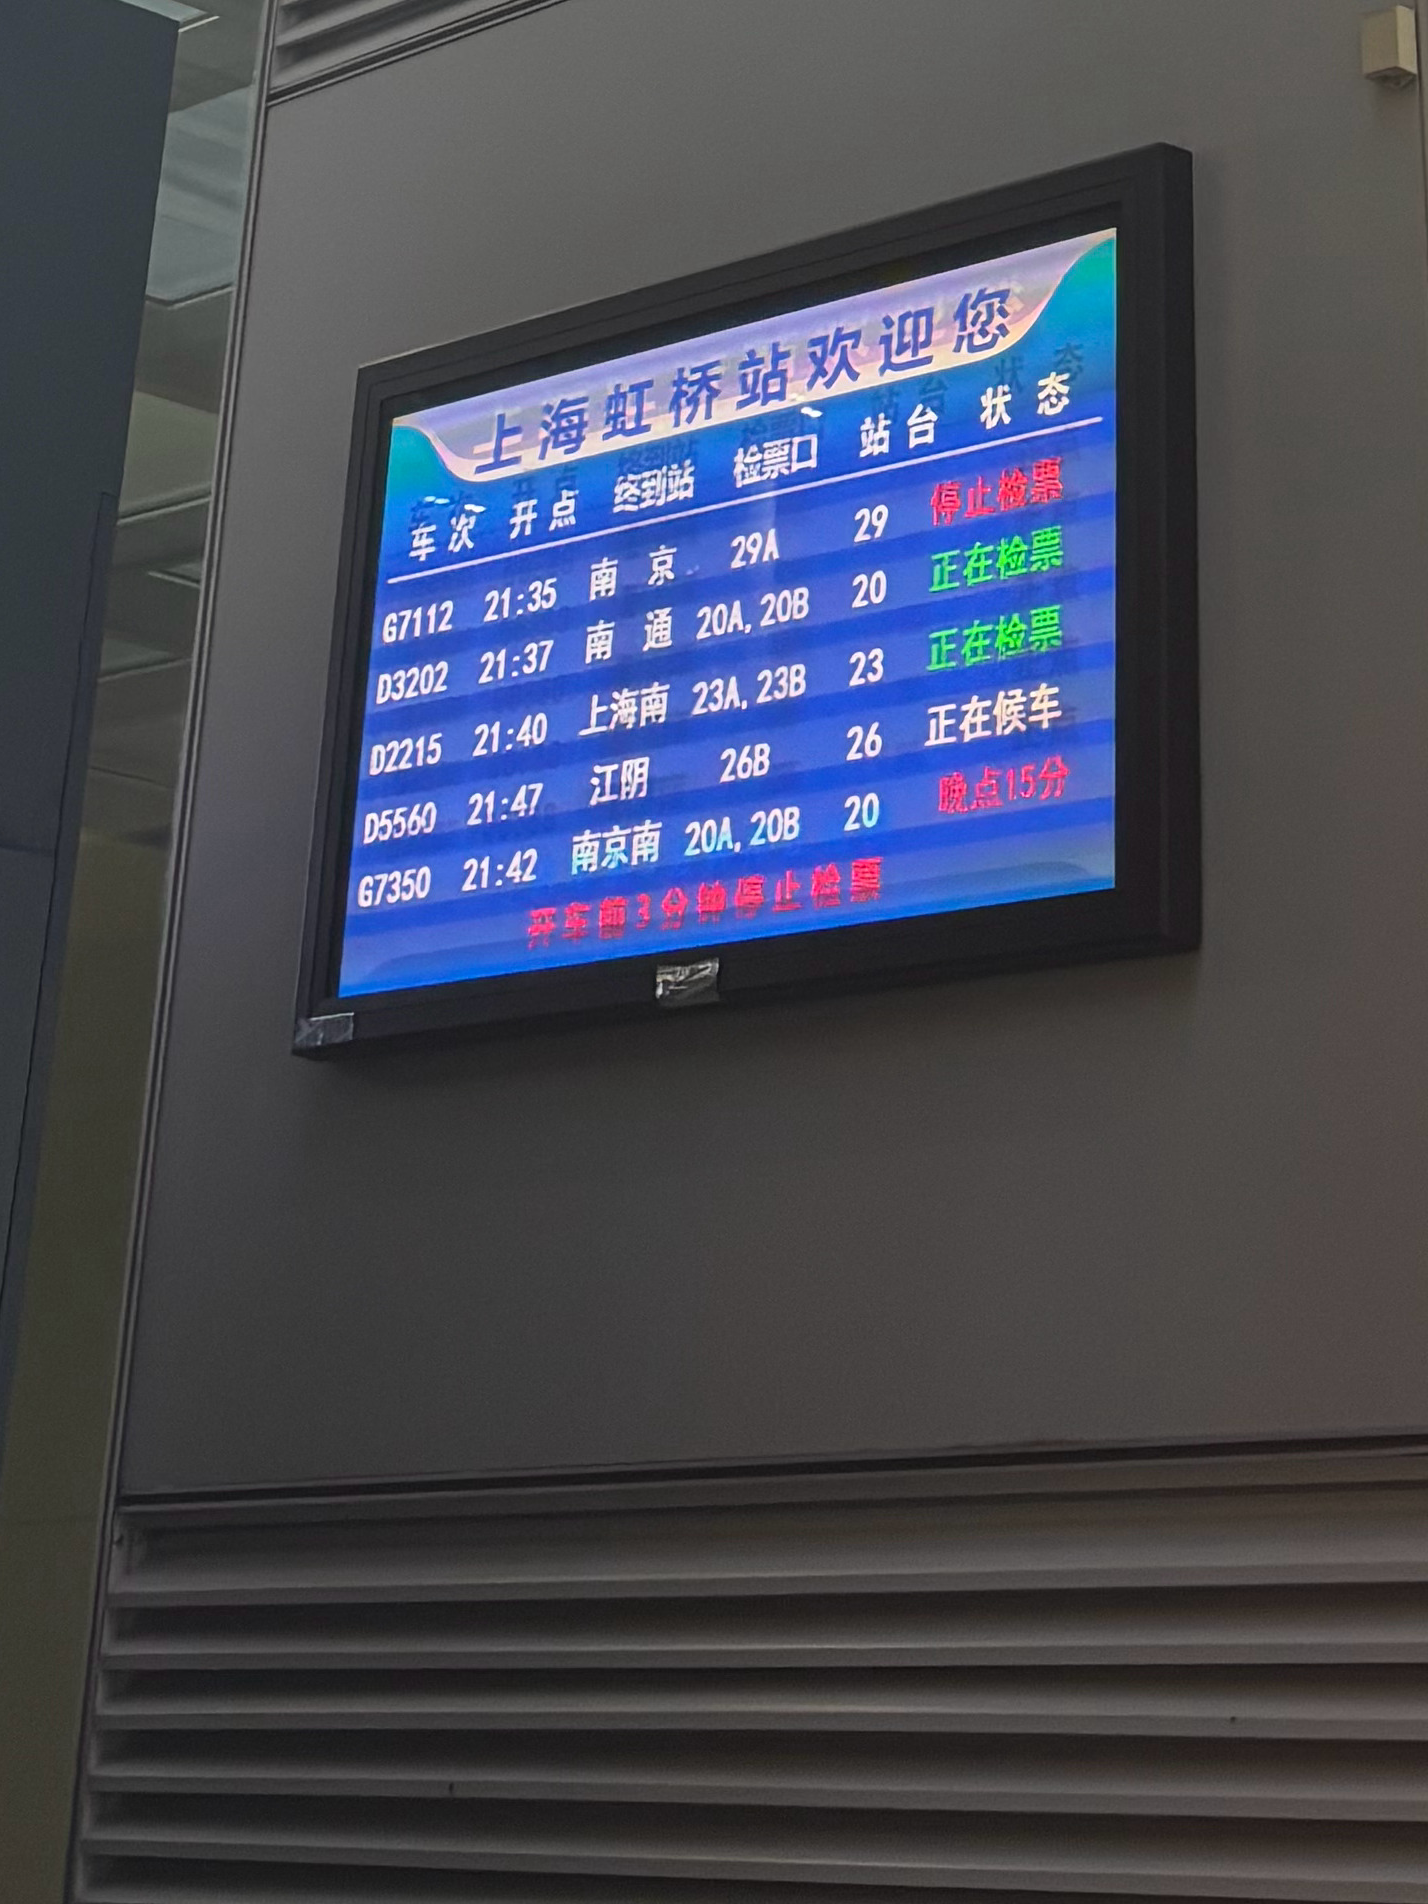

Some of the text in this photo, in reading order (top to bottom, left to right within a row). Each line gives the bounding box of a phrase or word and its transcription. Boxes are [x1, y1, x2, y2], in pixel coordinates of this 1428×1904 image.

[409, 371, 1071, 561] 车次 开点 终到站 检票口 站台 状态
[473, 288, 1012, 476] 上海虹桥站欢迎您
[376, 661, 449, 705] D3202
[478, 641, 554, 685] 21:37
[584, 608, 673, 664] 南通
[851, 571, 887, 609] 20
[928, 526, 1064, 593] 正在检票
[382, 456, 1064, 645] G7112 21:35 南京 29A 29 停止检票
[363, 683, 1062, 845] D5560 21:47 江阴 26B 26 正在候车
[369, 733, 443, 777] D2215
[472, 712, 548, 758] 21:40
[578, 682, 670, 738] 上海南
[848, 648, 884, 687] 23
[926, 604, 1063, 671] 正在检票
[357, 866, 431, 909] G7350
[461, 848, 538, 892] 21:42
[571, 820, 662, 876] 南京南
[844, 792, 880, 832] 20
[938, 755, 1069, 814] 晚点15分
